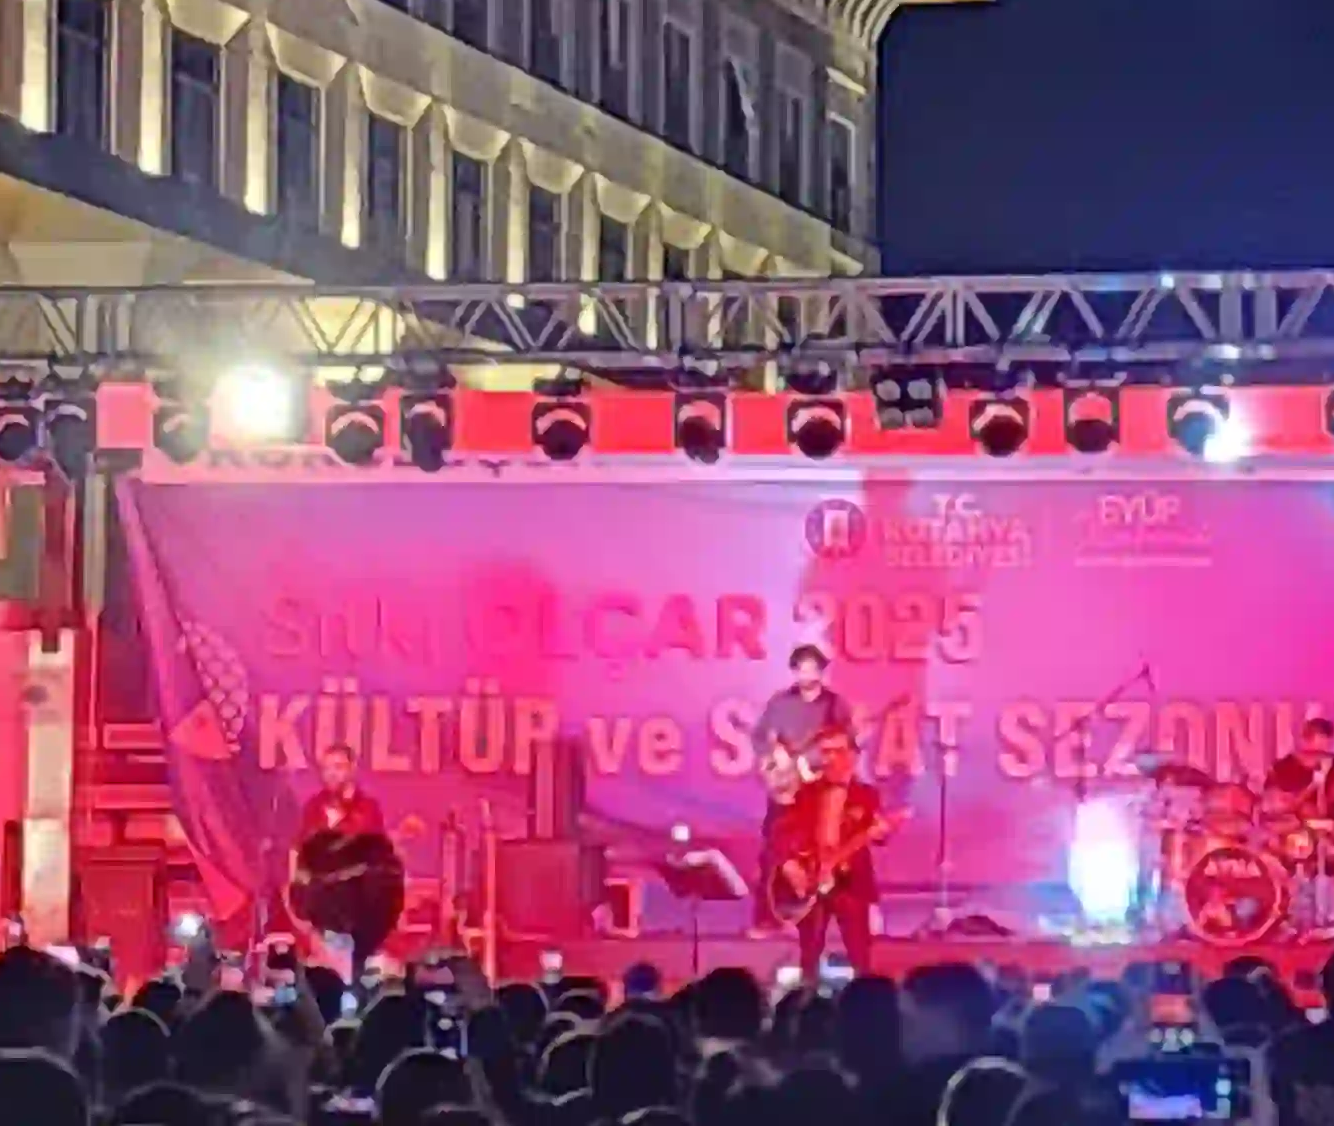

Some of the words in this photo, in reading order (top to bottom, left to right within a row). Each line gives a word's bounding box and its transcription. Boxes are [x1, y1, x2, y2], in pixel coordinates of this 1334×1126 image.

[793, 591, 984, 665] 2025
[259, 677, 559, 775] KÜLTÜR
[585, 716, 684, 775] ve
[708, 698, 972, 778] SAT
